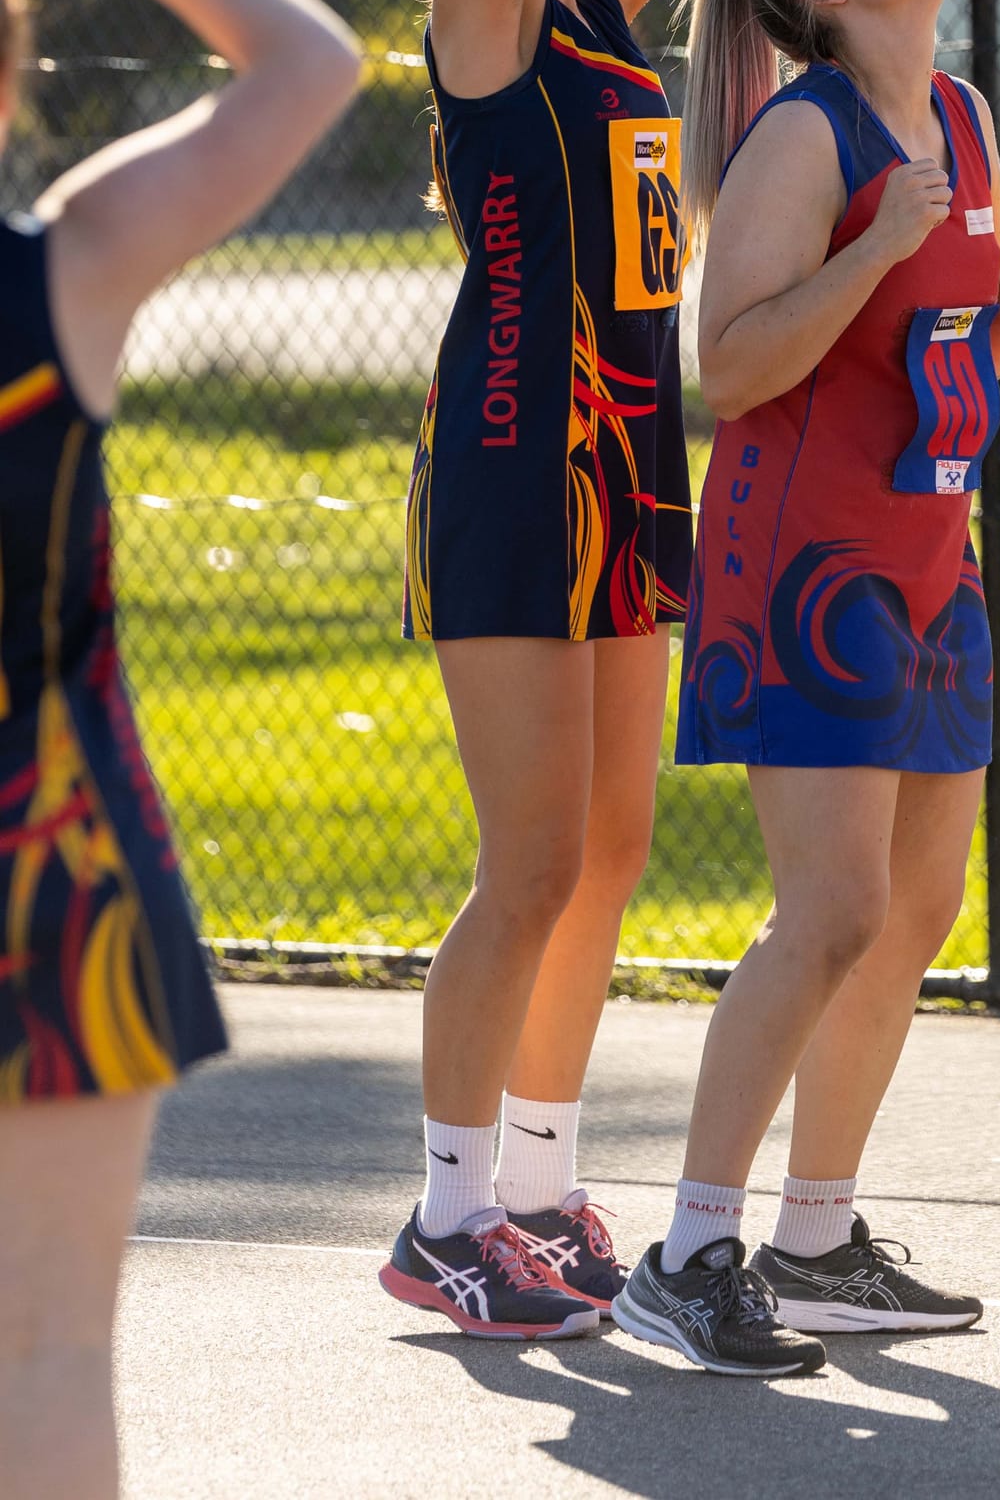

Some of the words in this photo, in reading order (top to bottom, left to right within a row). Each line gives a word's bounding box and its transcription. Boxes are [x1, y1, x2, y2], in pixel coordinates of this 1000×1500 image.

[481, 171, 521, 447] LONGWARRY
[725, 444, 760, 576] BULN
[687, 1201, 726, 1213] BULN
[834, 1197, 854, 1205] BU
